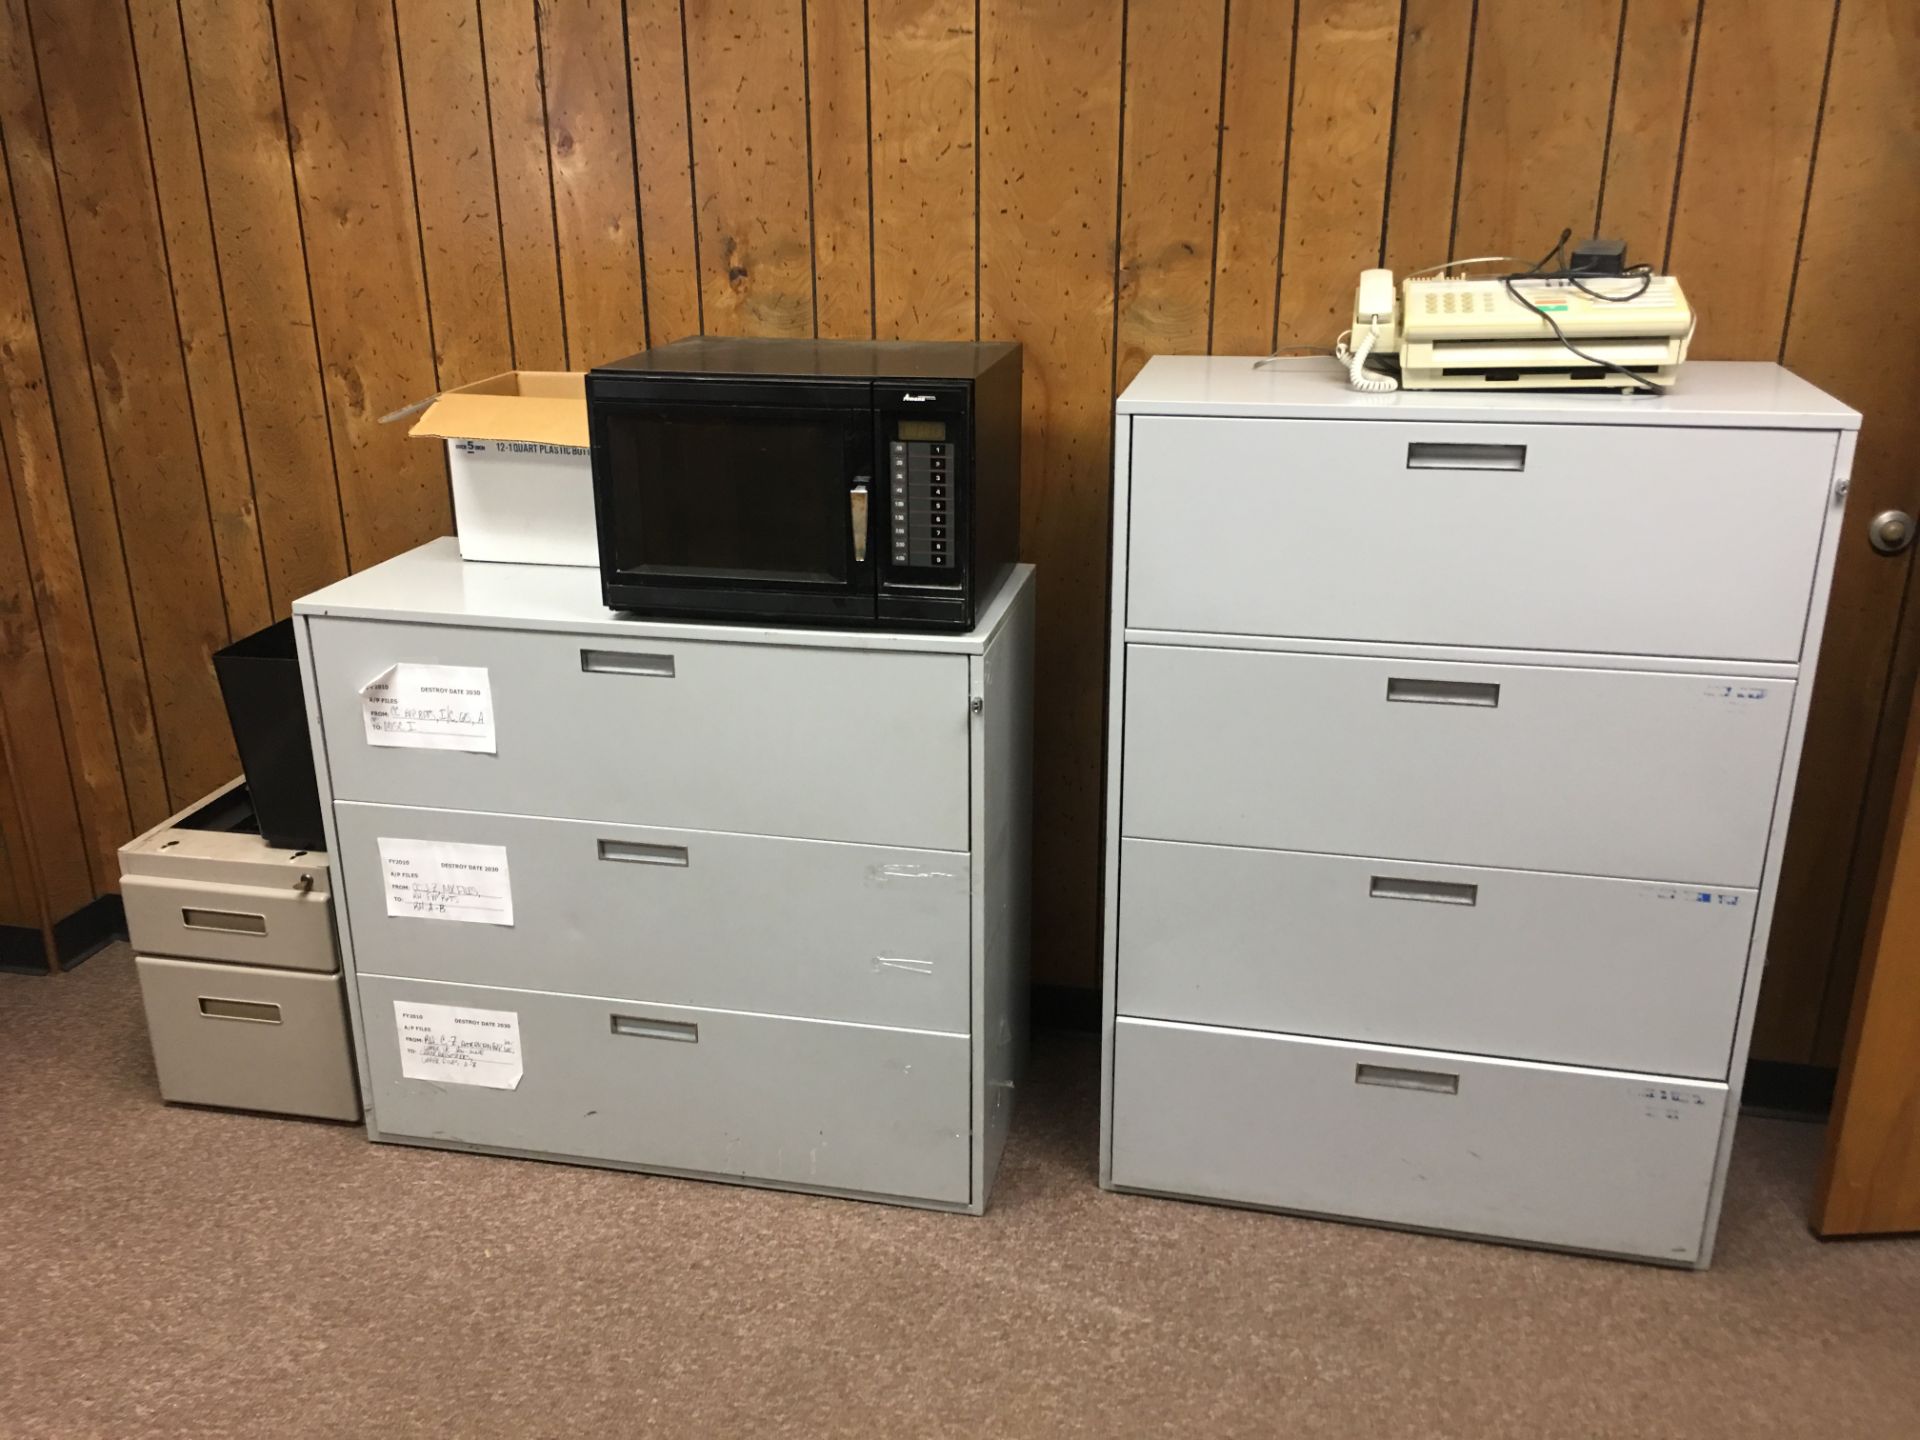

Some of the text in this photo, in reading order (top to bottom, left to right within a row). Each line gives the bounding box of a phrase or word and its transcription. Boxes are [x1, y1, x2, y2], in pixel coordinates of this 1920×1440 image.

[513, 442, 537, 453] QUART
[539, 444, 571, 455] PLASTIC
[420, 686, 448, 694] DESTROY
[440, 862, 467, 870] DESTROY
[454, 1018, 480, 1026] DESTROY
